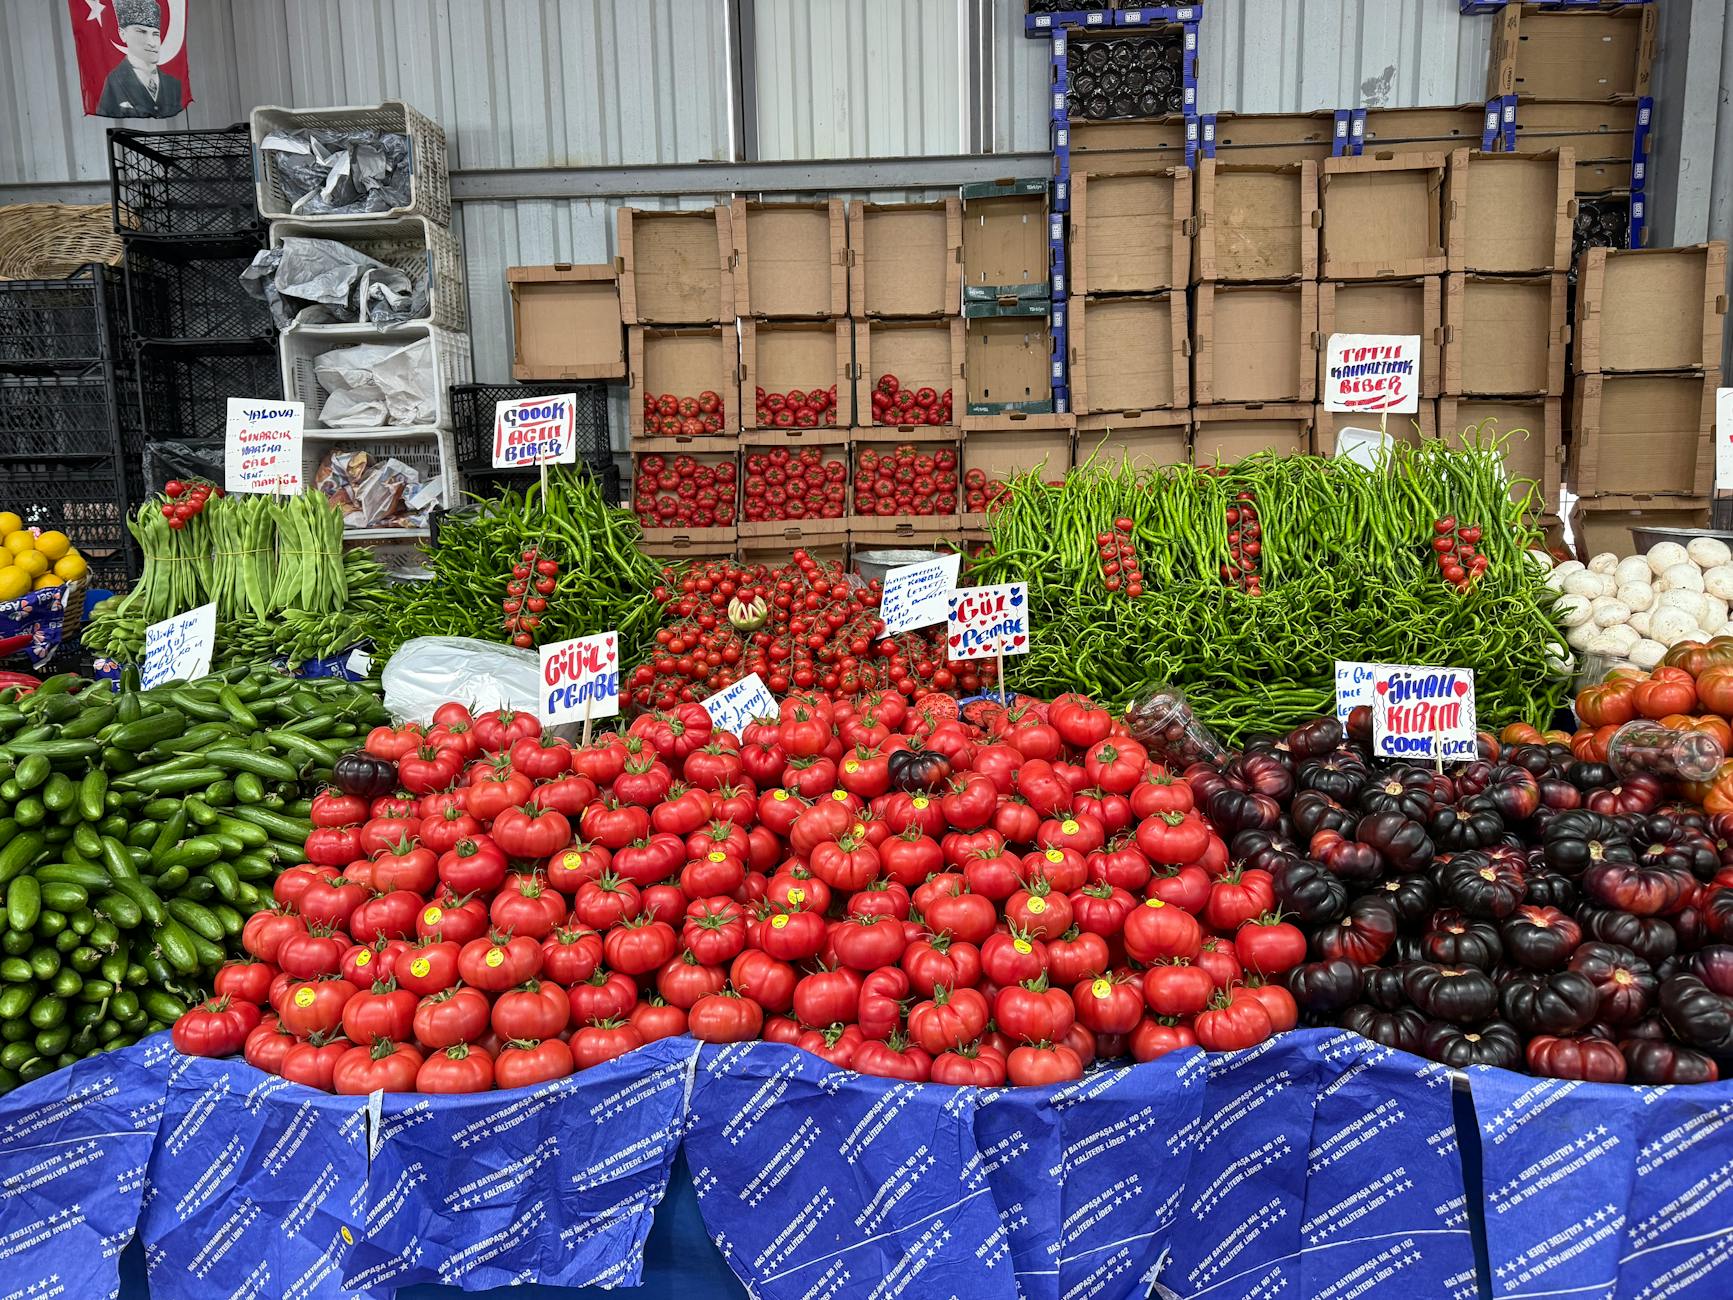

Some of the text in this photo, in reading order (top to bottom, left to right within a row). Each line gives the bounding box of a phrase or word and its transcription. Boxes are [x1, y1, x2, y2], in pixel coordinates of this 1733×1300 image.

[243, 409, 294, 421] YALOVA
[958, 592, 1009, 623] GÜL
[962, 618, 1024, 648] PEMBE
[545, 642, 607, 686] GÜL
[549, 671, 618, 714] PEMBE
[1388, 673, 1456, 704] SİYAH
